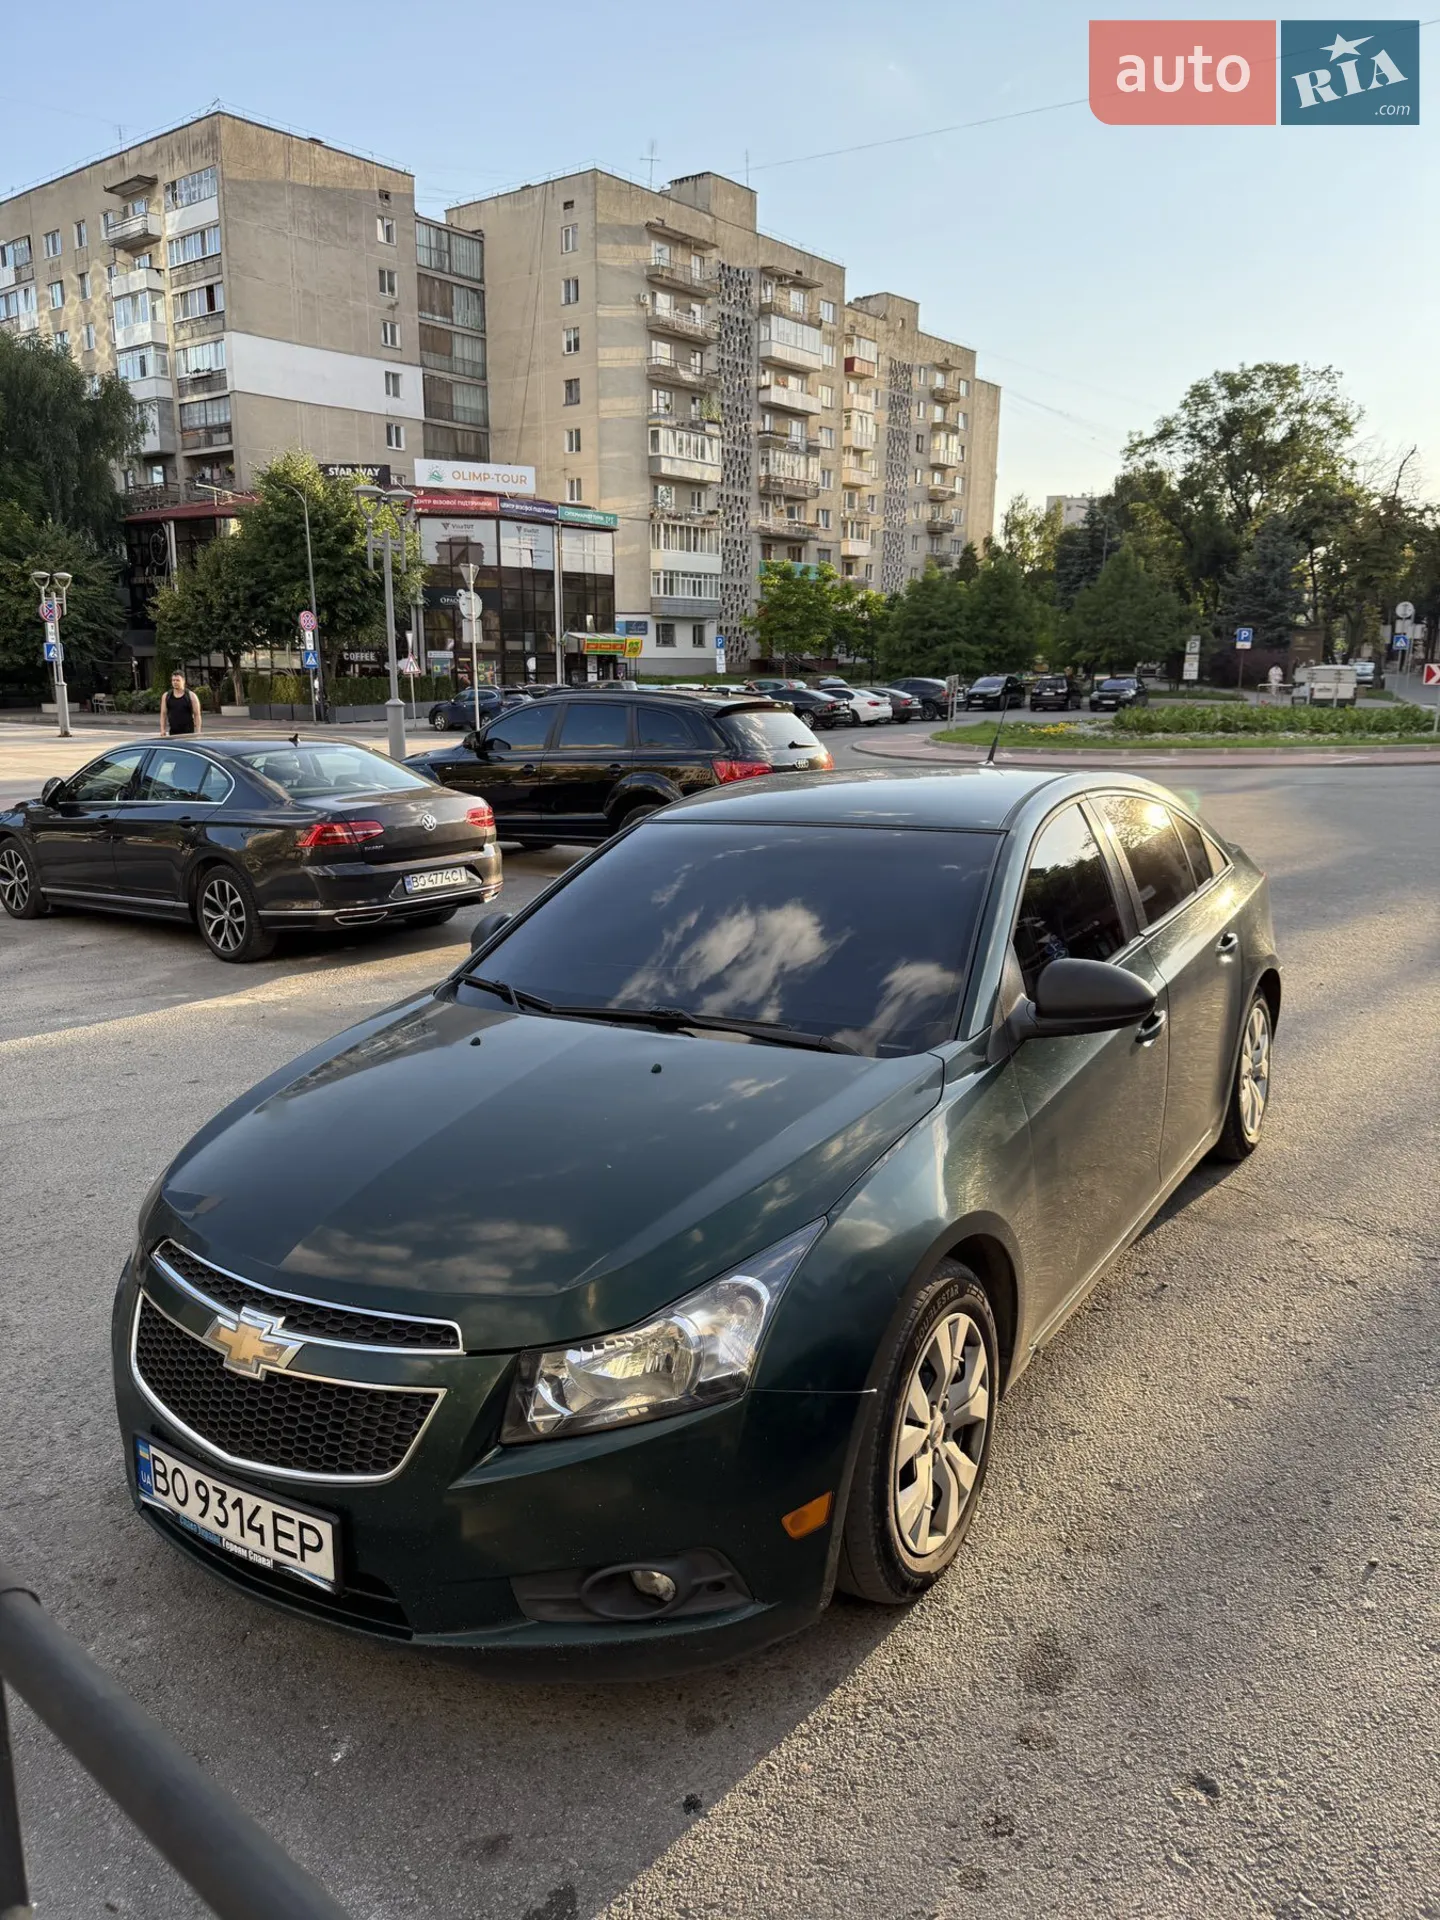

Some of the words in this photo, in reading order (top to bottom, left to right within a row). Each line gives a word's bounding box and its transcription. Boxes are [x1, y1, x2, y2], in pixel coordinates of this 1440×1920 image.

[452, 469, 527, 486] OLIMP-TOUR
[343, 651, 376, 662] COFFEE
[195, 1479, 266, 1547] 9314
[272, 1510, 324, 1563] EP
